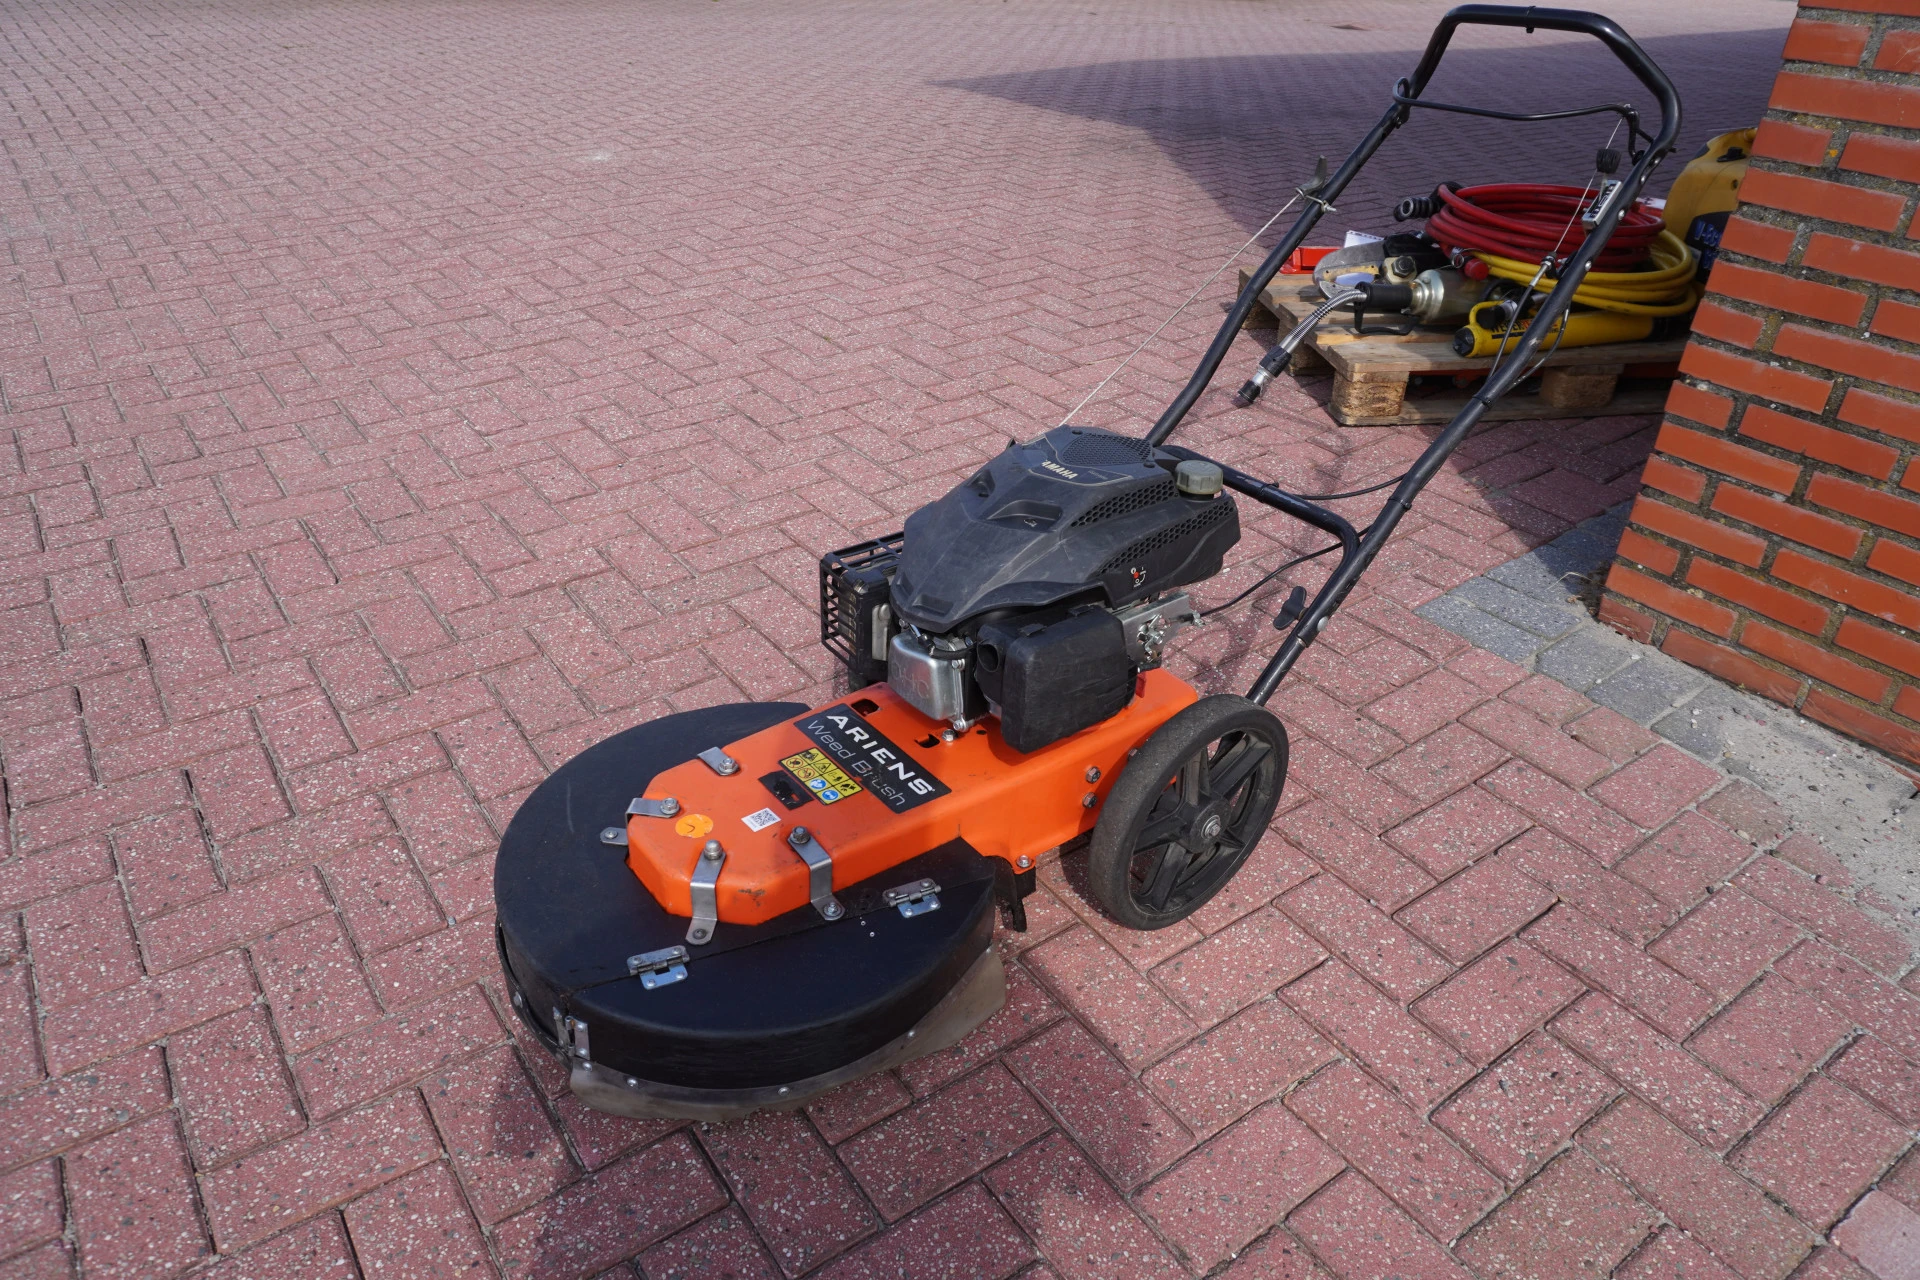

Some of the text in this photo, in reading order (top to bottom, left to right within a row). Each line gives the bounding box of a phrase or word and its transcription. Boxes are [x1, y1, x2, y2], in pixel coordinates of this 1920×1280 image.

[1041, 459, 1078, 479] AMAHA
[807, 720, 906, 806] Weed Brush
[826, 715, 932, 795] ARIENS
